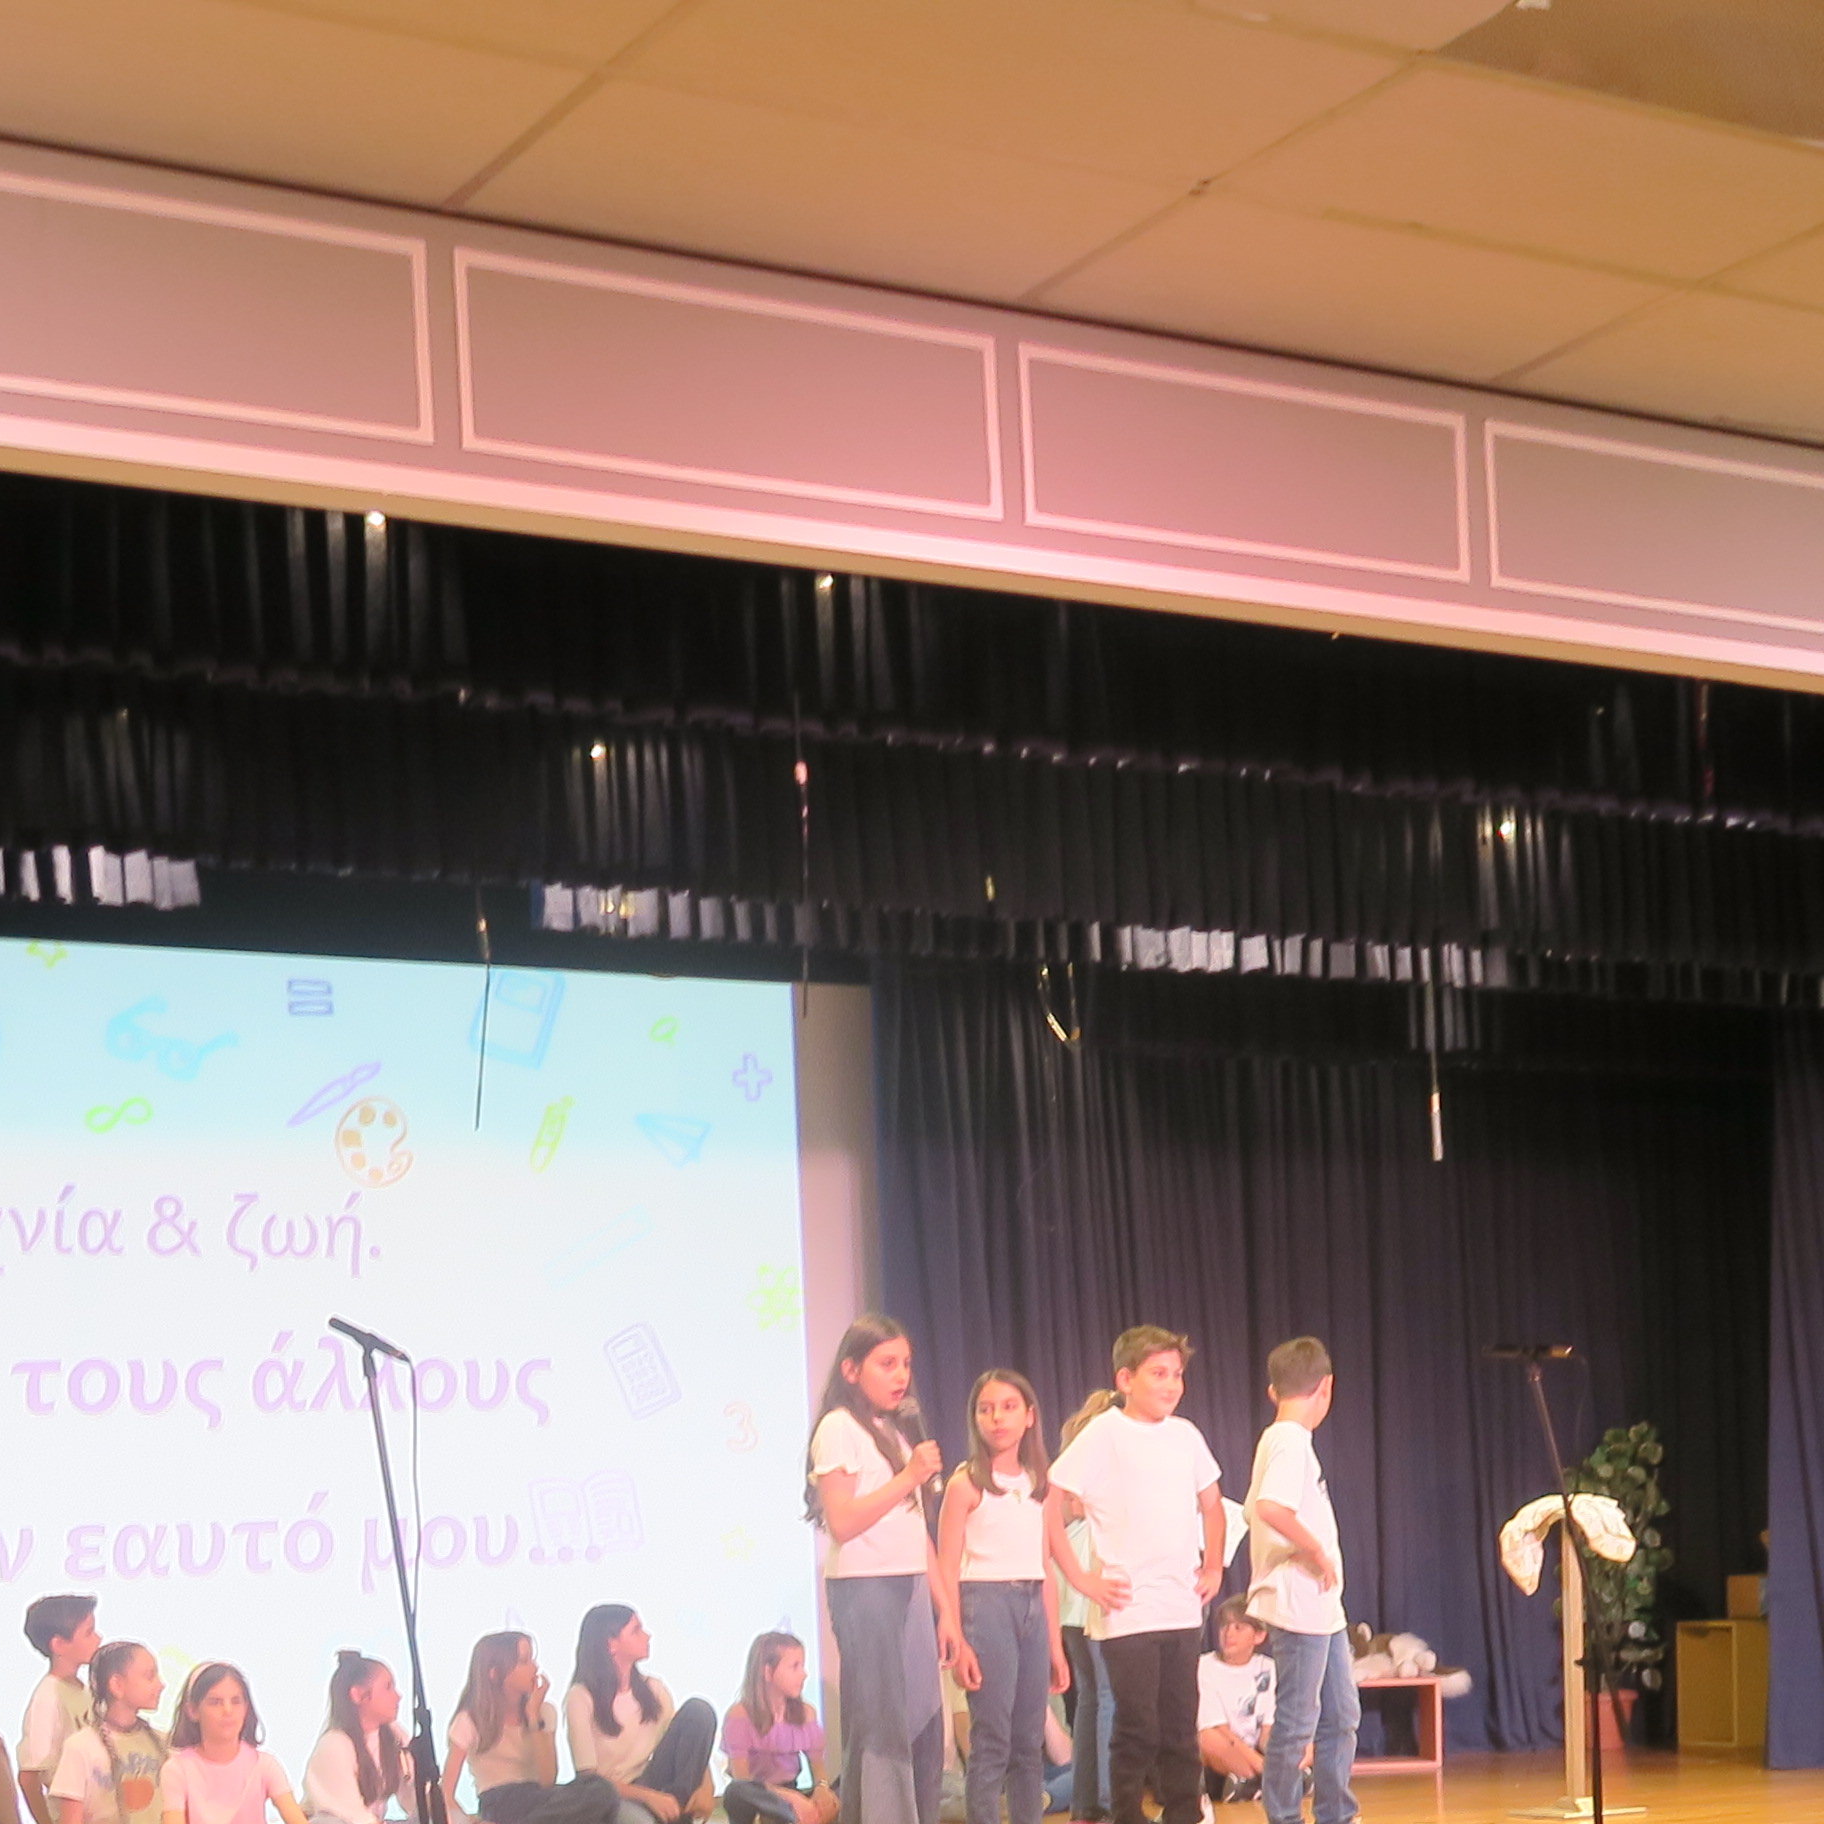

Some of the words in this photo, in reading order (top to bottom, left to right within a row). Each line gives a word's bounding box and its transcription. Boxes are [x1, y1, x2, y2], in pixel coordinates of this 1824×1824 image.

[146, 1195, 200, 1256] &
[227, 1192, 381, 1276] ζωή.
[11, 1357, 223, 1427] τους
[65, 1491, 334, 1580] εαυτό
